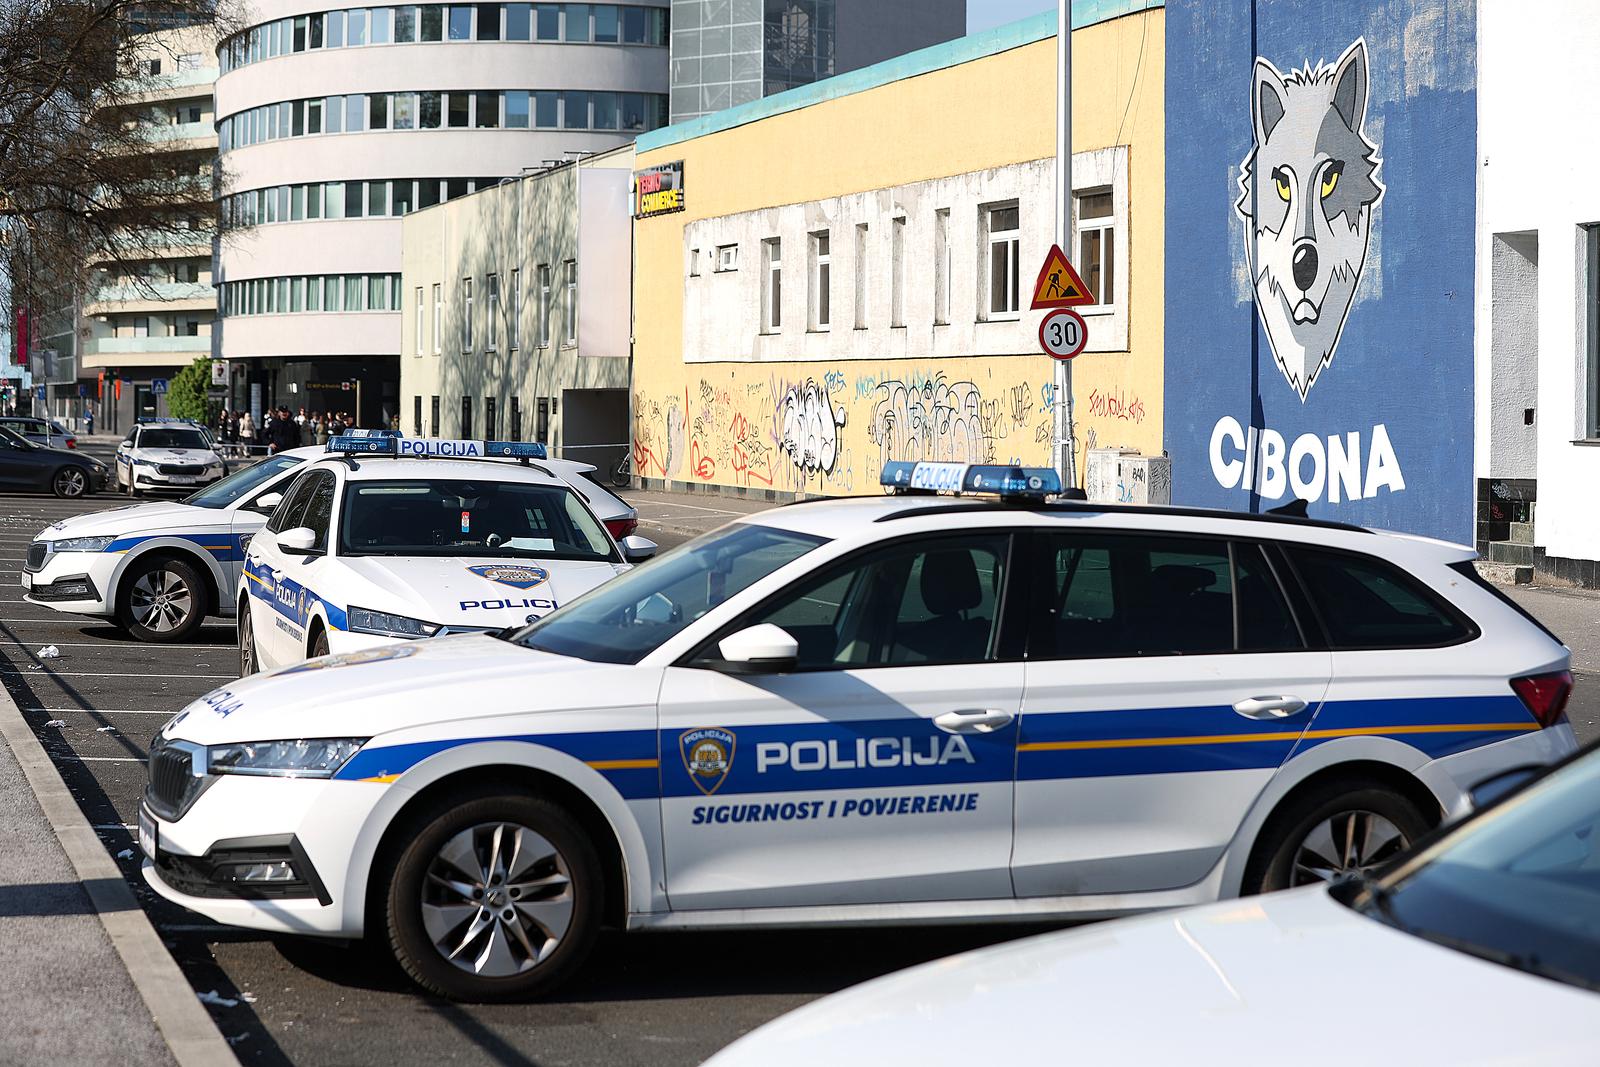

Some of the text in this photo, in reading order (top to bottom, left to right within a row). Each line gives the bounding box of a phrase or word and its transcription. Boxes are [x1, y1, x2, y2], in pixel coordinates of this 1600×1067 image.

[1050, 321, 1078, 347] 30
[401, 440, 479, 456] POLICIJA
[1209, 415, 1406, 504] CIBONA
[914, 467, 961, 491] POLICIJA
[757, 735, 976, 773] POLICIJA
[691, 793, 979, 825] SIGURNOST I POVJERENJE
